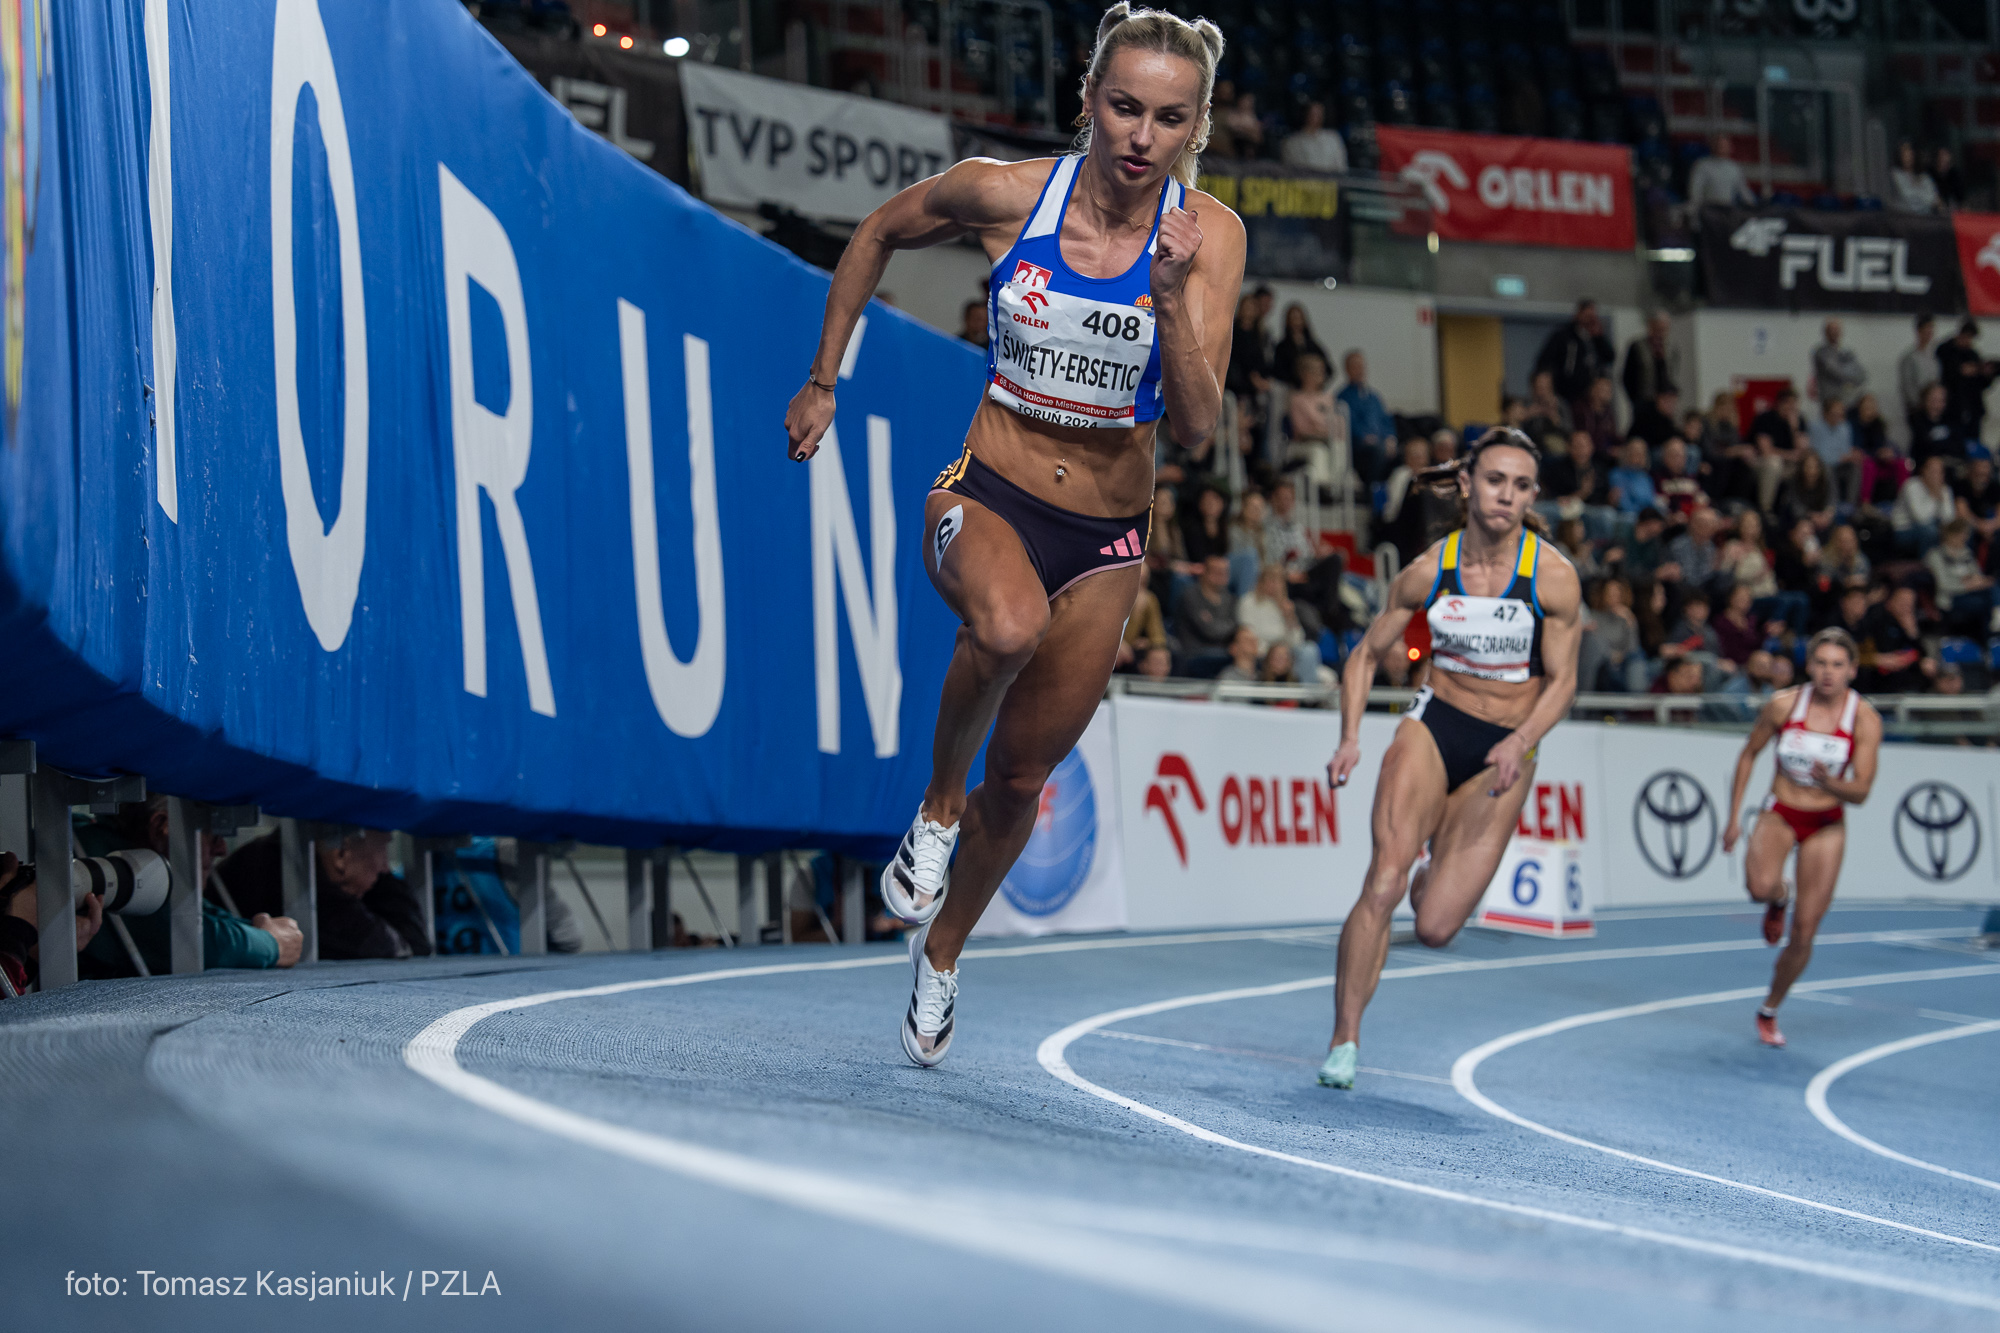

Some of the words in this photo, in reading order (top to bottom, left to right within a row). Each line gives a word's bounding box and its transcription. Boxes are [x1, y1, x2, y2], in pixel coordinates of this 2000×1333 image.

[553, 75, 655, 160] EL
[695, 107, 795, 170] TVP
[806, 129, 946, 188] SPORT
[1478, 165, 1615, 217] ORLEN
[1779, 234, 1932, 295] FUEL
[1012, 313, 1050, 330] ORLEN
[1082, 310, 1141, 341] 408
[1003, 330, 1141, 392] ŚWIĘTY-ERSETIC
[1008, 383, 1023, 396] PZLA
[1023, 391, 1054, 406] Halowe
[1055, 400, 1107, 417] Mistrzostwa
[1108, 407, 1130, 417] Polski
[1017, 402, 1062, 424] TORUŃ
[1064, 415, 1098, 429] 2024
[1219, 774, 1339, 847] ORLEN
[1516, 781, 1586, 842] LEN
[1511, 859, 1541, 907] 6
